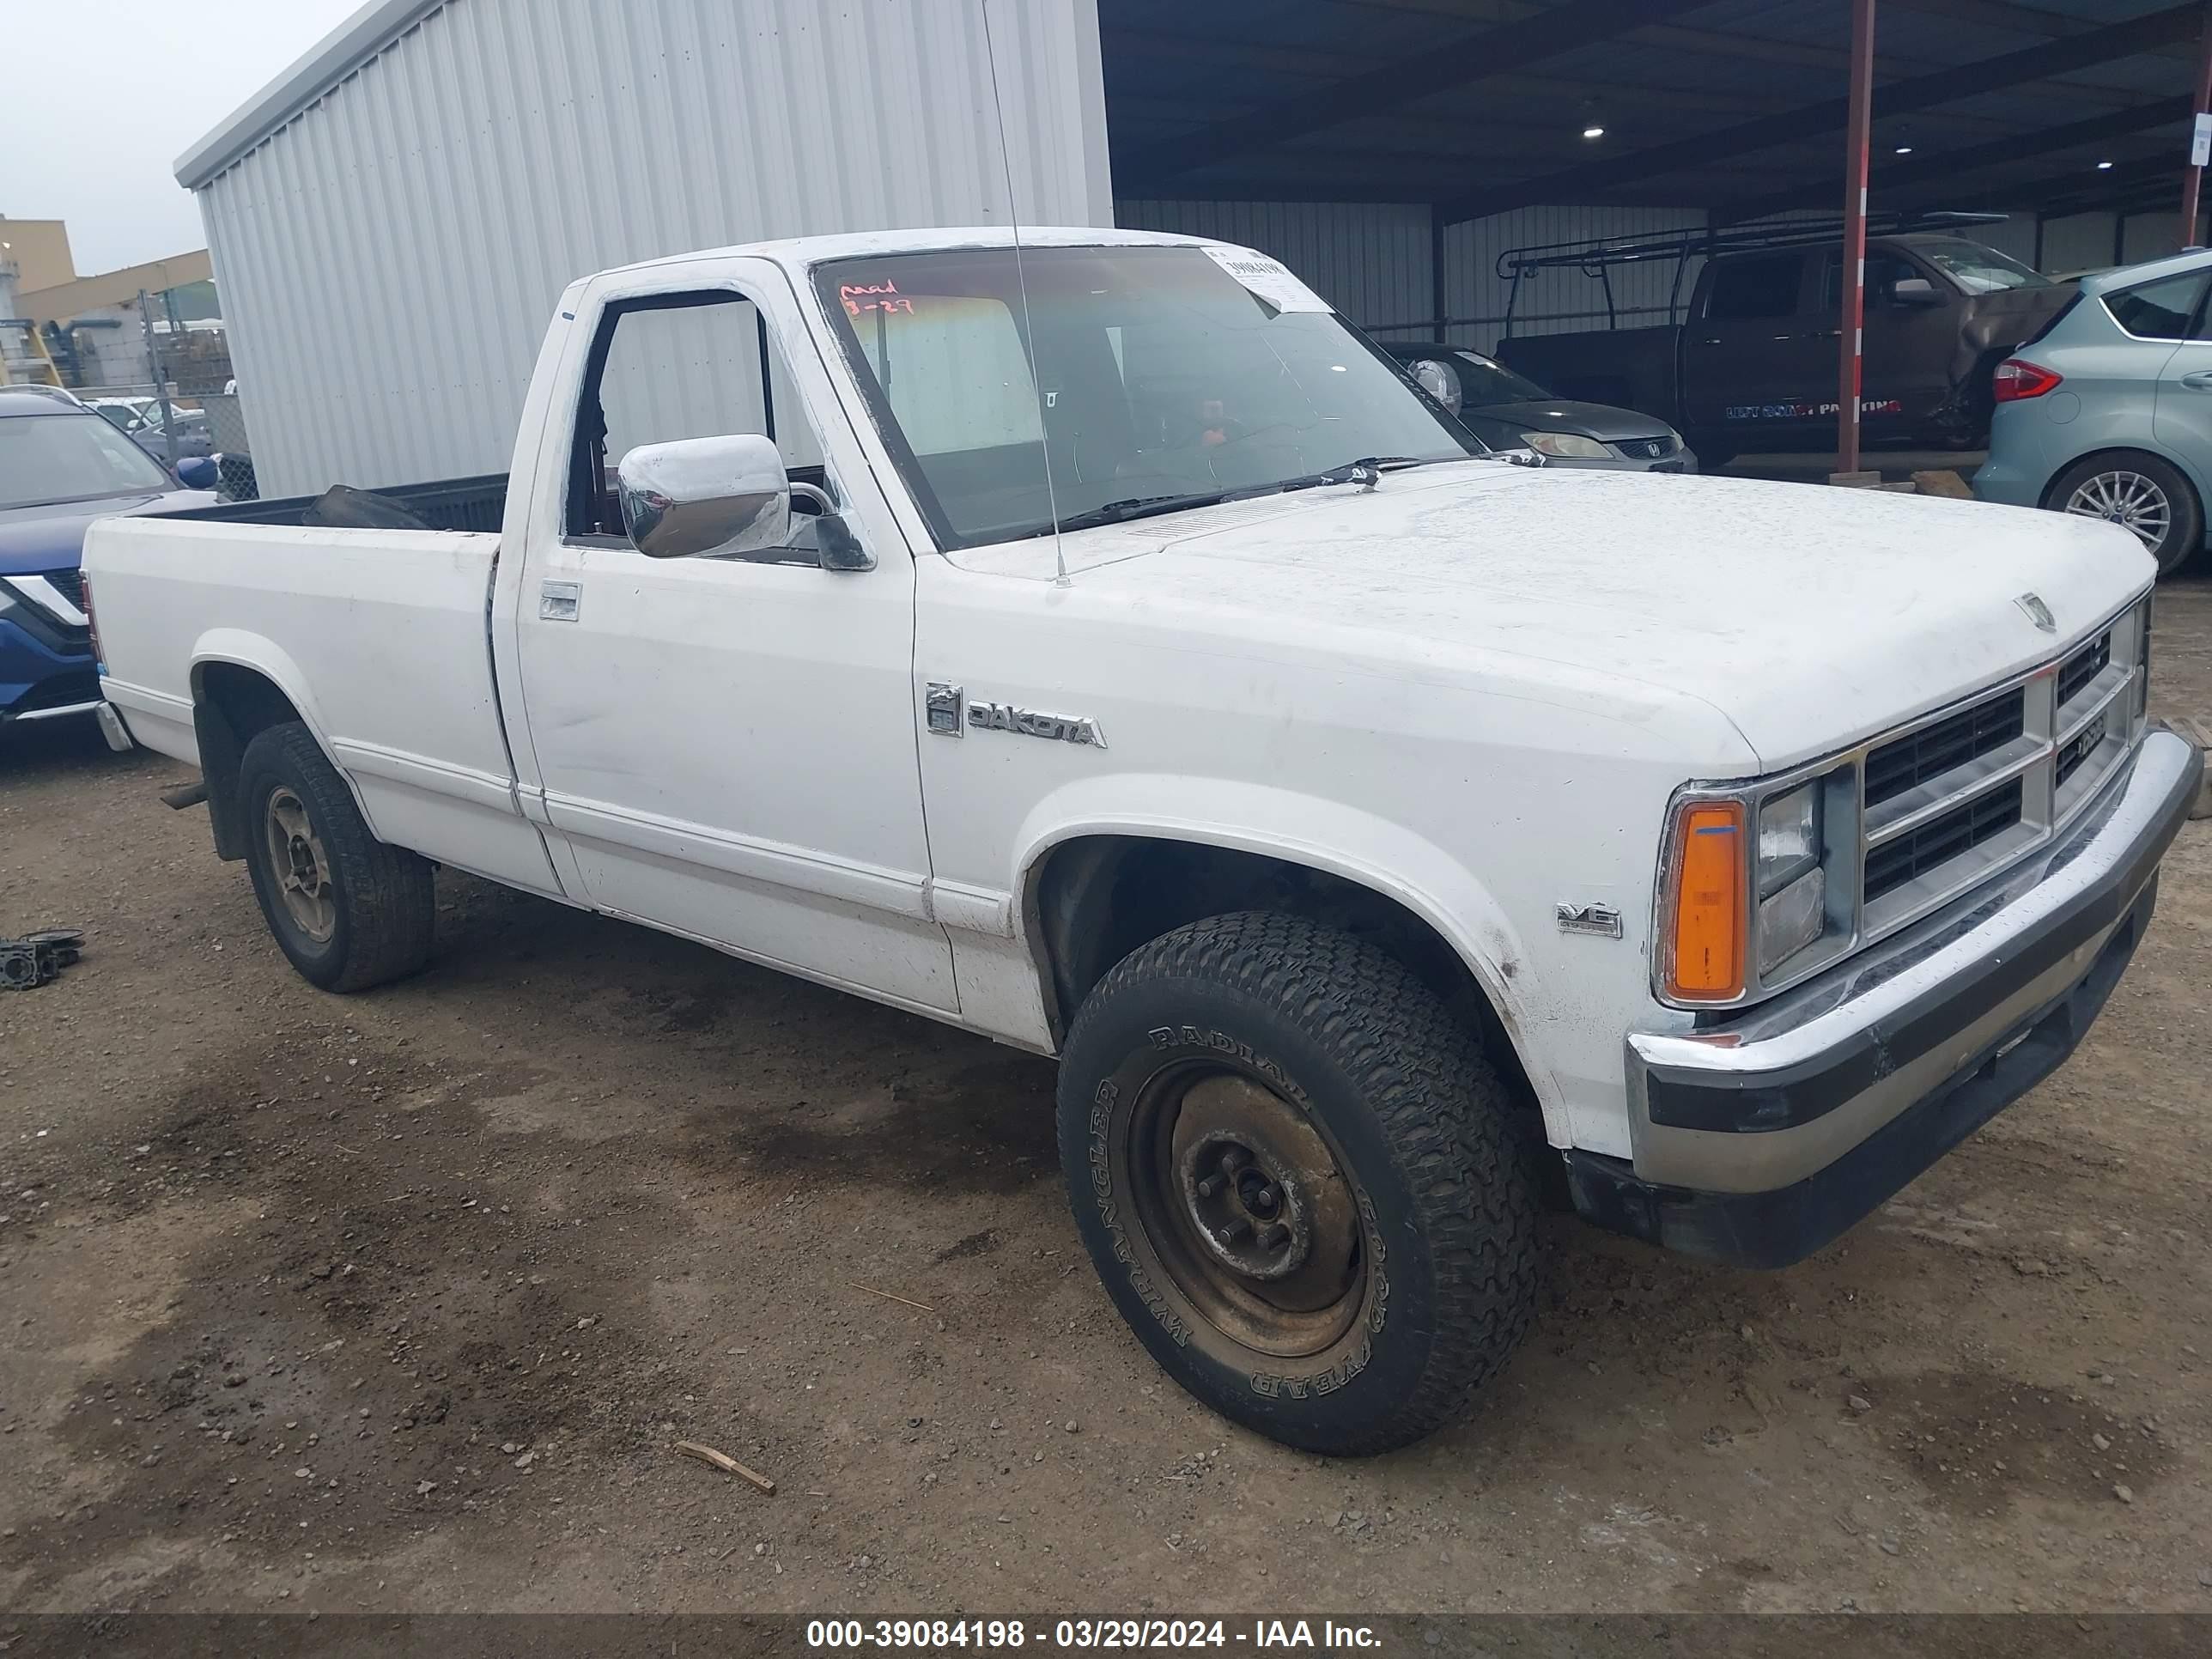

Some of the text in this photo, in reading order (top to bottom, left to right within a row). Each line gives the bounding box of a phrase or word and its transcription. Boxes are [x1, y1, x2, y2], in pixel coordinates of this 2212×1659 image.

[1226, 261, 1285, 275] 39084198
[1726, 406, 1759, 418] LEFT
[968, 700, 1108, 749] DAKOTA
[1557, 902, 1620, 925] V6
[1089, 1079, 1193, 1348] WRANGLER
